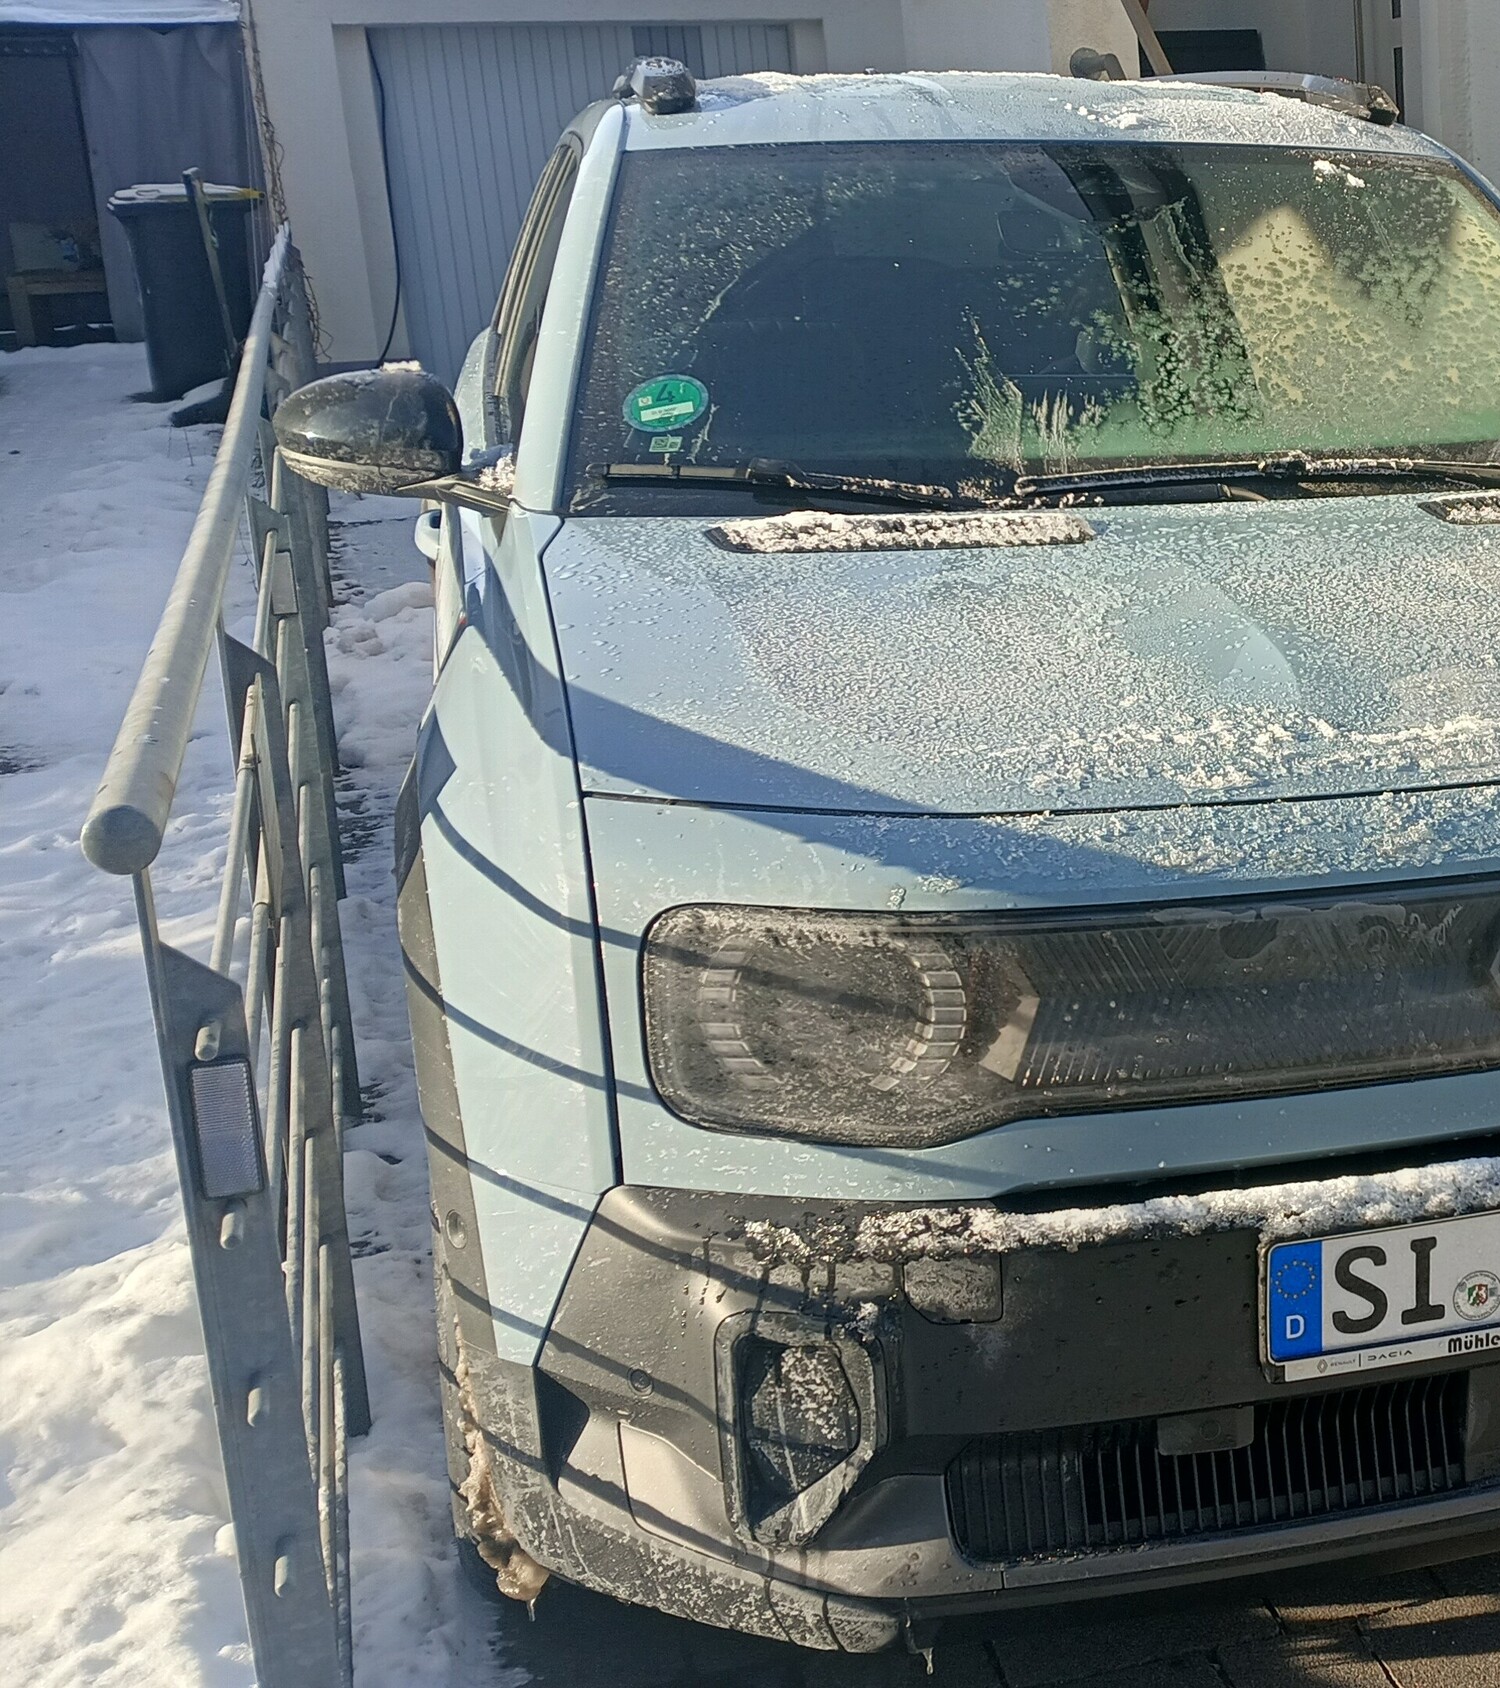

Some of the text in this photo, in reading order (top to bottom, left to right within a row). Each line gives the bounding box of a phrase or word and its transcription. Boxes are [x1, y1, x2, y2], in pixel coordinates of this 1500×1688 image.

[656, 383, 676, 402] 4
[1332, 1236, 1446, 1334] SI
[1285, 1314, 1305, 1339] D
[1367, 1350, 1413, 1362] DACIA
